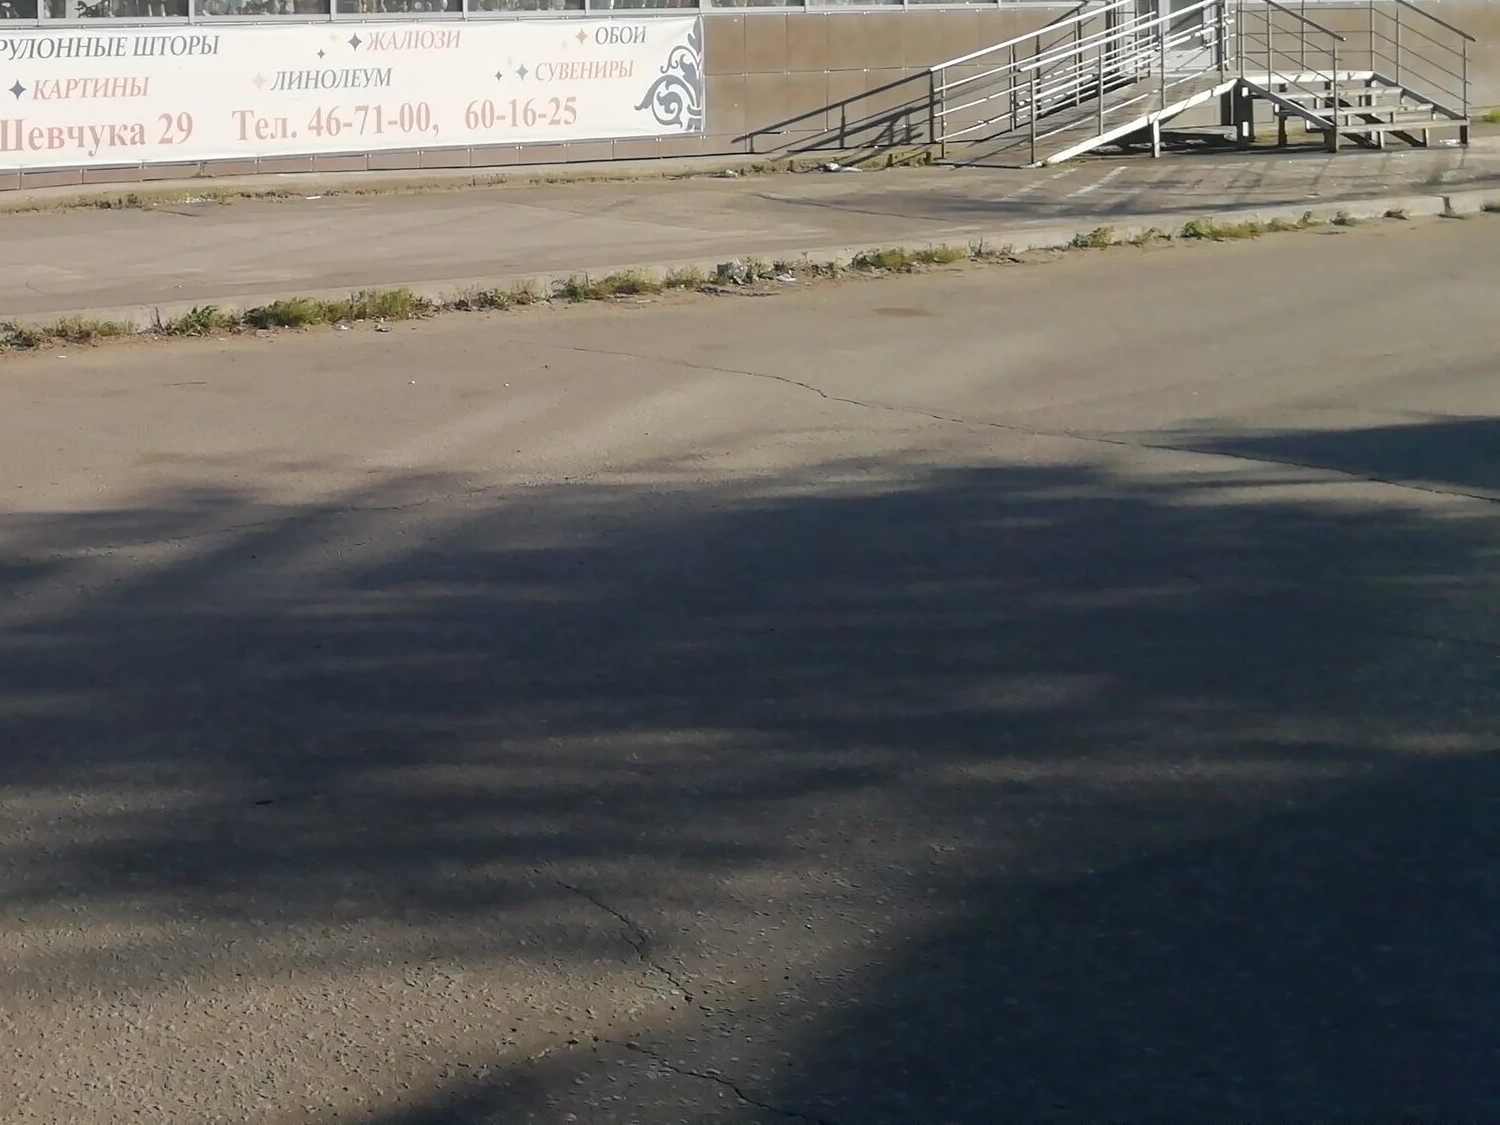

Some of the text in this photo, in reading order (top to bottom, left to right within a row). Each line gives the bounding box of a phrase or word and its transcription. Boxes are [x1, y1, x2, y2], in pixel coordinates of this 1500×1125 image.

[132, 33, 221, 57] ШТОРЫ
[365, 28, 461, 51] ЖАЛЮЗИ
[594, 25, 647, 46] ОБОИ
[271, 66, 393, 92] ЛИНОЛЕУМ
[534, 59, 635, 83] СУВЕНИРЫ
[32, 75, 150, 101] КАРТИНЫ
[157, 111, 194, 144] 29
[231, 96, 578, 141] Тел. 46-71-00, 60-16-25
